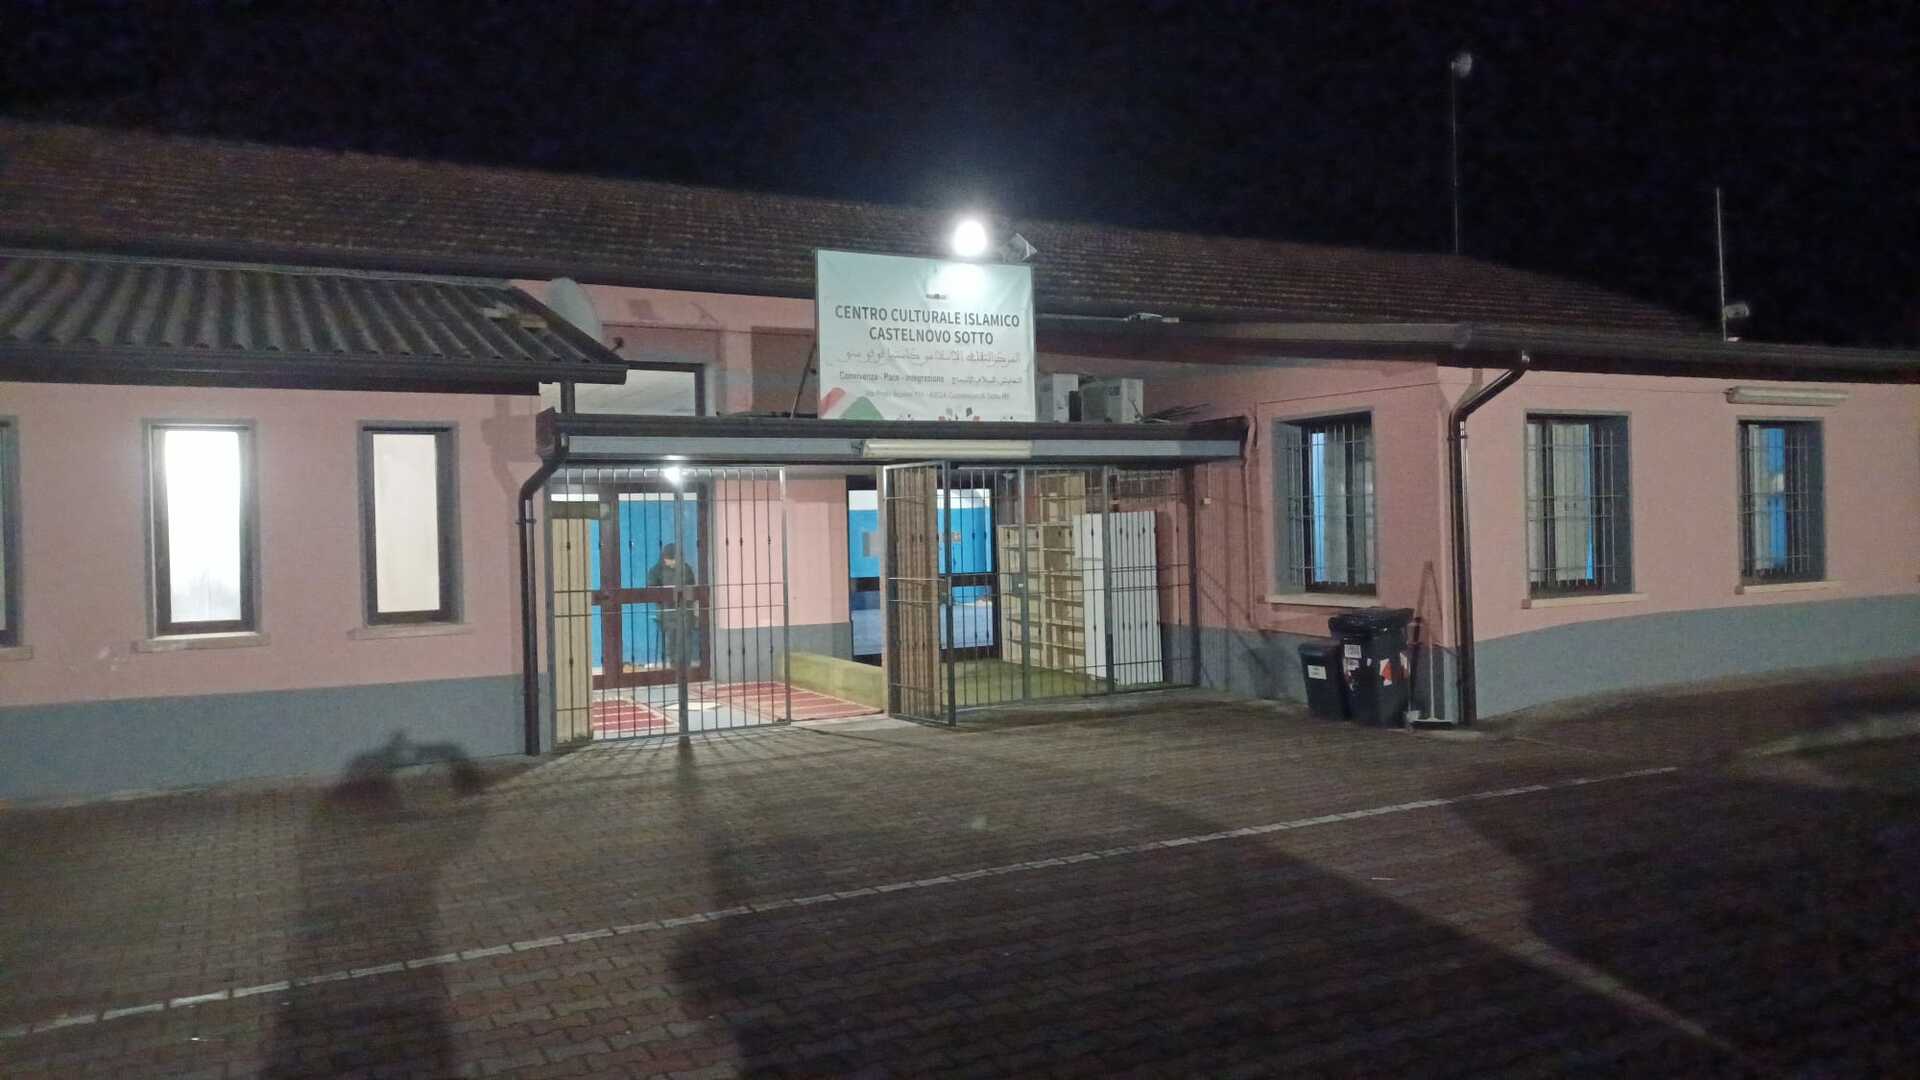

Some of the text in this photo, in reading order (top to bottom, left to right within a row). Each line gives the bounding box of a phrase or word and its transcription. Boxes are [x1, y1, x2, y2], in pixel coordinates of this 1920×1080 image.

[834, 304, 1020, 328] CENTRO CULTURALE ISLAMICO
[869, 326, 994, 345] CASTELNOVO SOTTO
